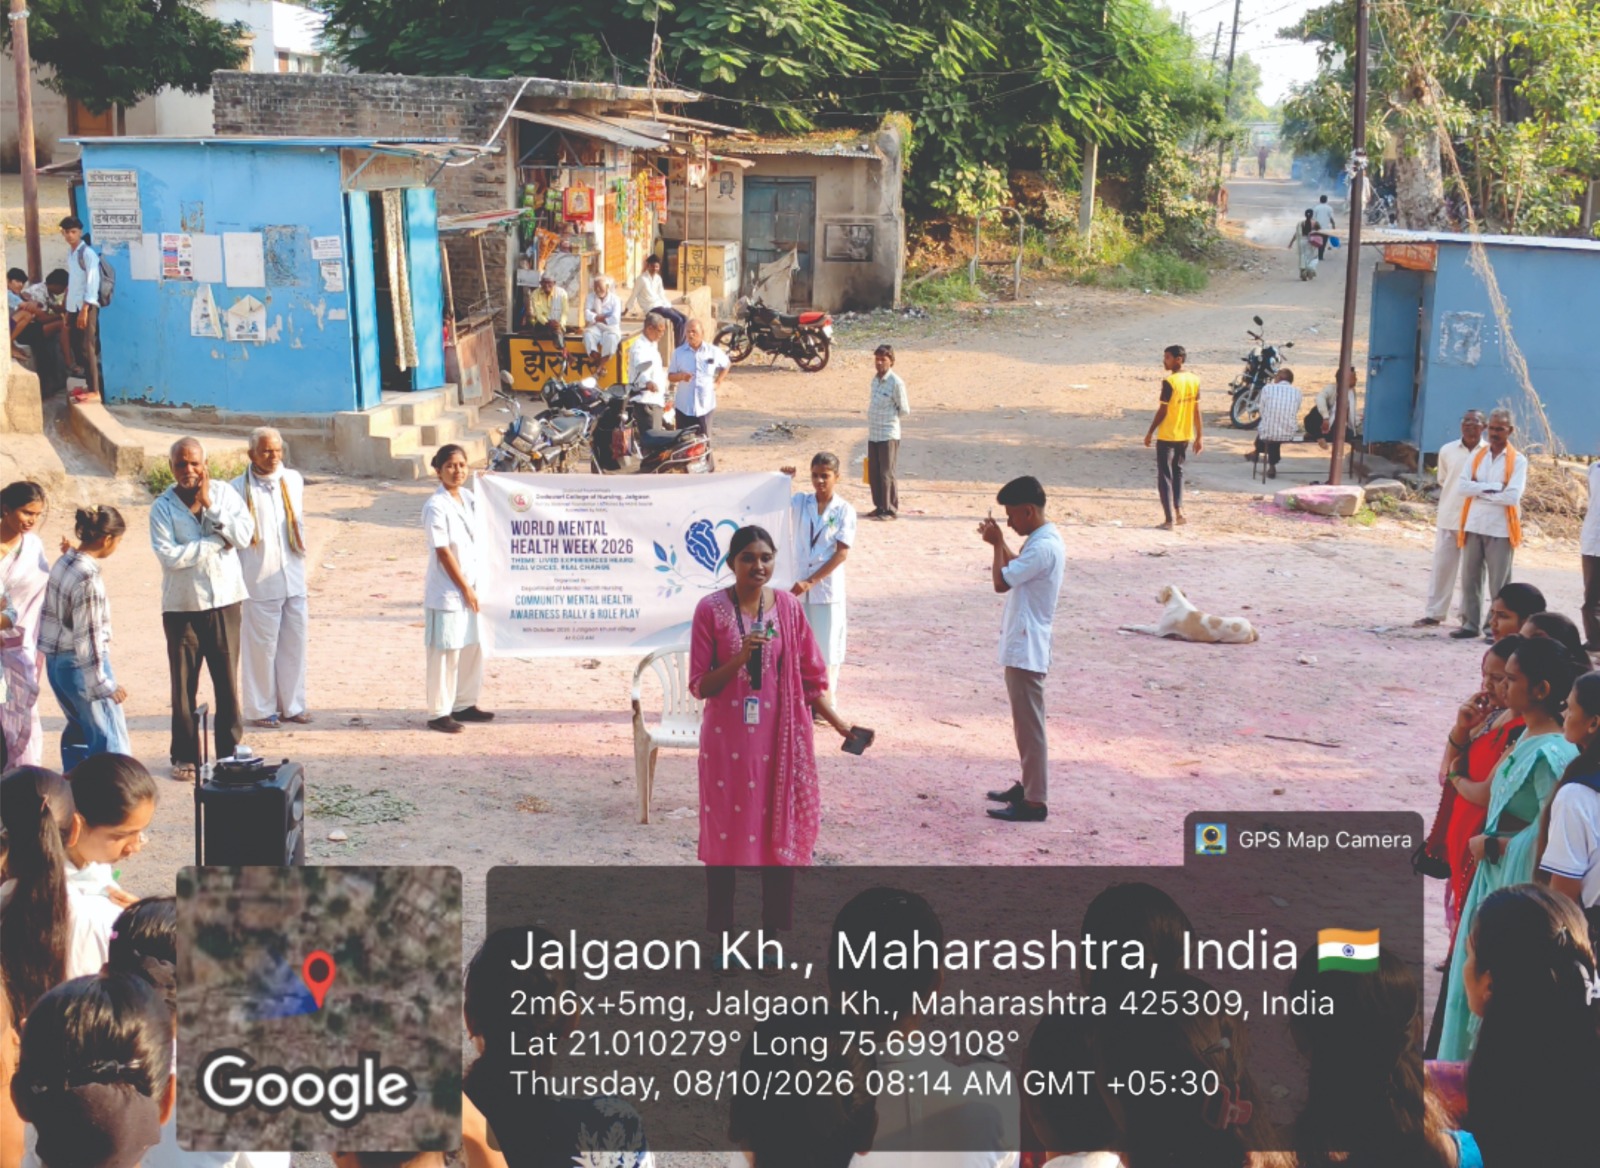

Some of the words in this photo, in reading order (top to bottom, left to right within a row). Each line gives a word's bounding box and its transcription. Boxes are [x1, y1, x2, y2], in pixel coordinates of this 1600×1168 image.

[511, 520, 555, 536] WORLD
[558, 520, 608, 536] MENTAL
[511, 539, 559, 554] HEALTH
[562, 539, 598, 554] WEEK
[601, 539, 634, 554] 2026
[515, 595, 565, 606] COMMUNITY
[567, 595, 599, 606] MENTAL
[601, 595, 633, 605] HEALTH
[509, 608, 560, 620] AWARENESS
[562, 608, 589, 620] RALLY
[590, 609, 595, 620] &
[597, 608, 617, 620] ROLE
[620, 607, 641, 620] PLAY
